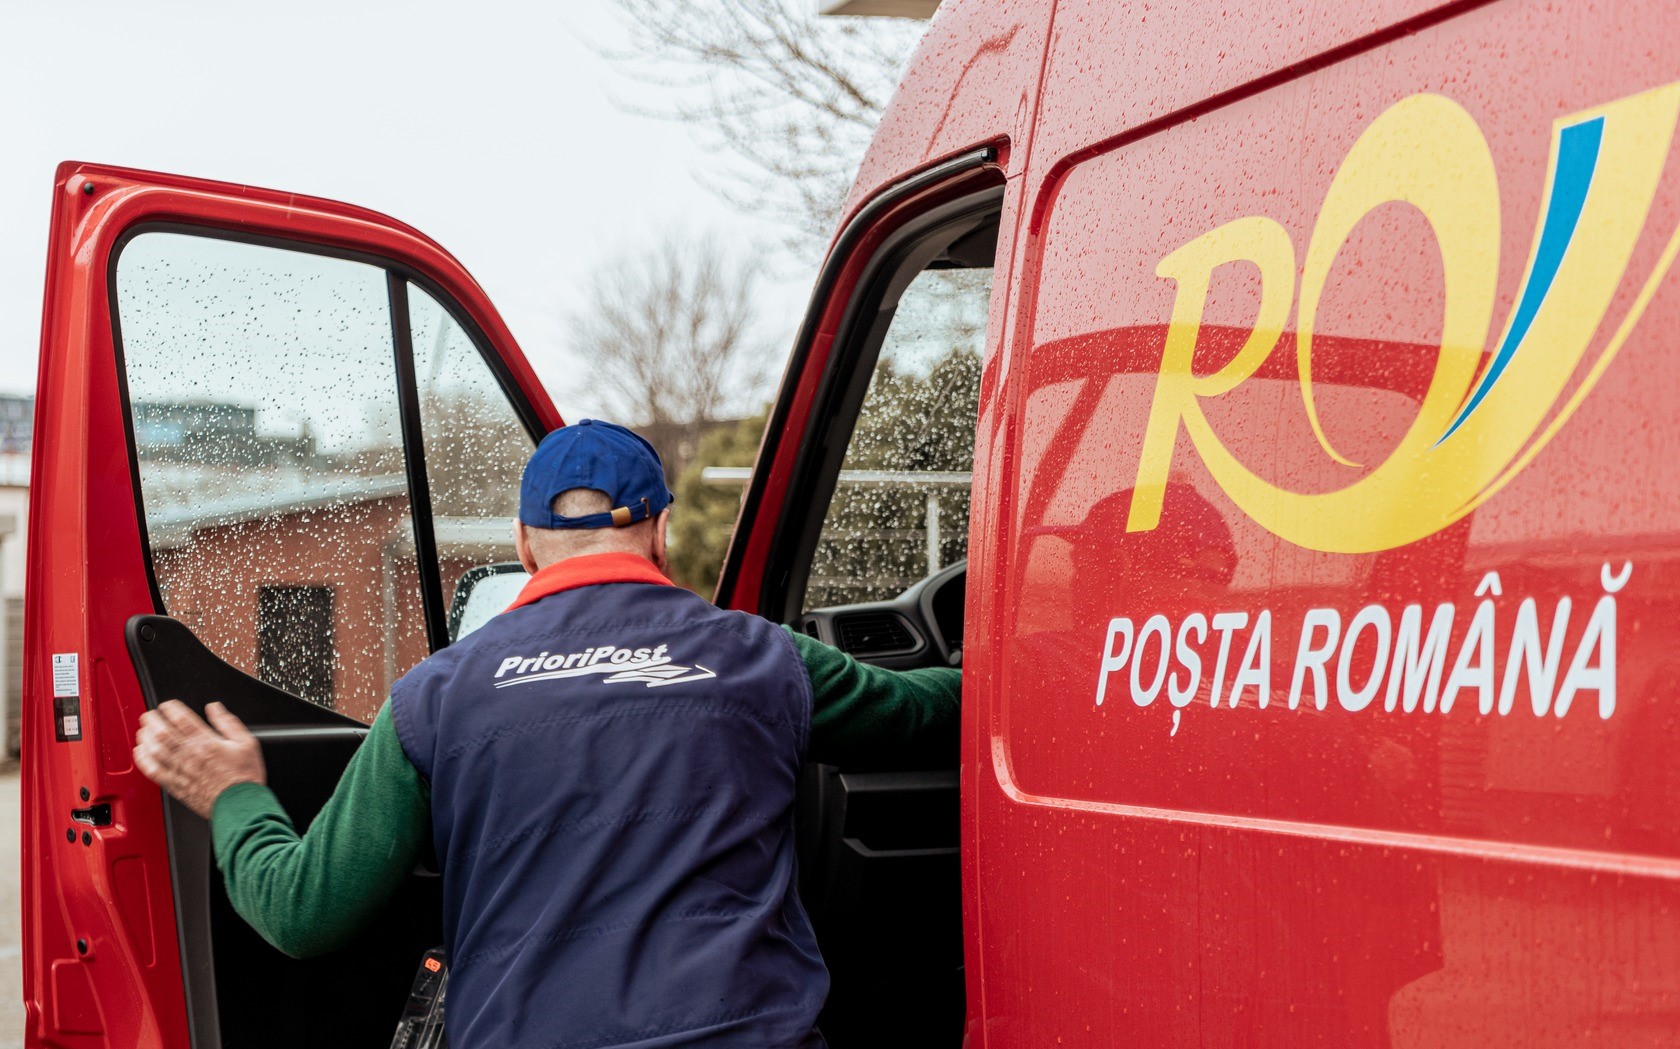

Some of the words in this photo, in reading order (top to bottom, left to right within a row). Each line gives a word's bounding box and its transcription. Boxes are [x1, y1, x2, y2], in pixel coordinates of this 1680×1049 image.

[493, 643, 671, 679] PrioriPost
[1096, 608, 1273, 738] POȘTA
[1287, 560, 1634, 720] ROMÂNĂ
